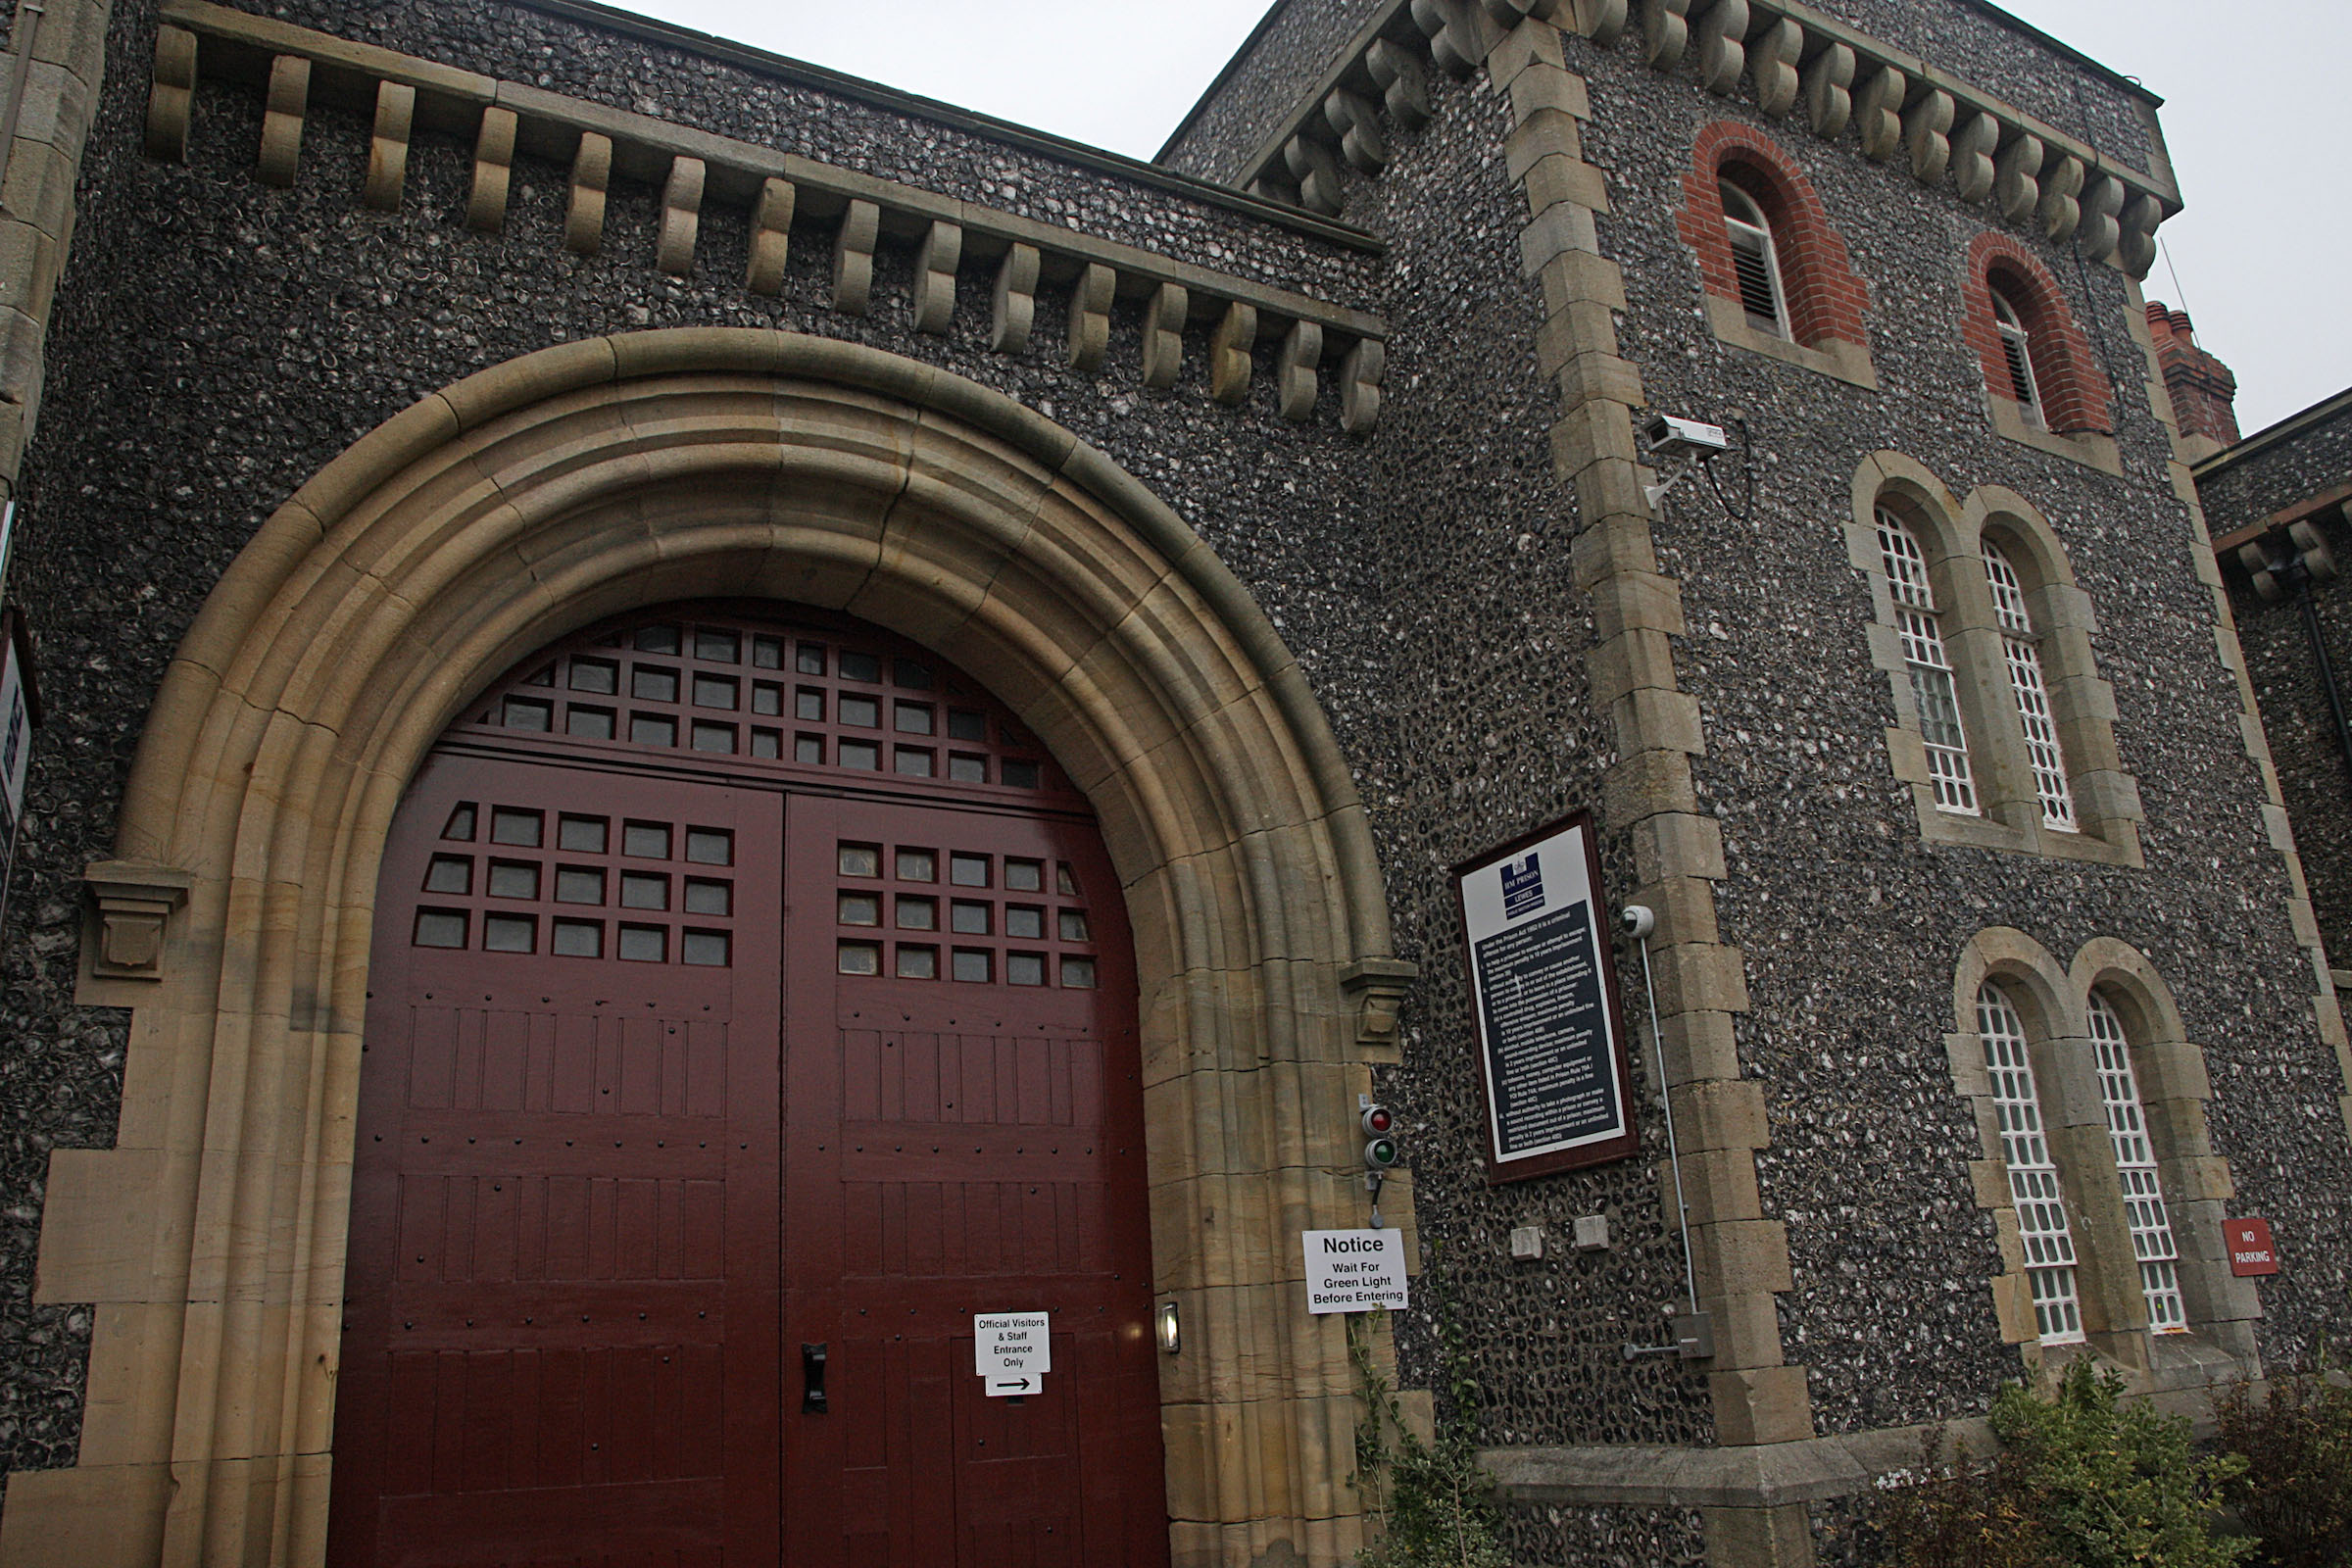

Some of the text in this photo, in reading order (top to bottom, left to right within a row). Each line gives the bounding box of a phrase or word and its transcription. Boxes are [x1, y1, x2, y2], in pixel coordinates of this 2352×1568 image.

[1516, 868, 1539, 885] PRISON
[1514, 889, 1533, 903] LEWES
[2242, 1231, 2254, 1242] NO
[1324, 1237, 1384, 1252] Notice
[2234, 1250, 2270, 1263] PARKING
[1333, 1262, 1380, 1273] Wait For
[1324, 1276, 1392, 1289] Green Light
[1314, 1291, 1403, 1303] Before Entering
[979, 1319, 1009, 1329] Official
[1007, 1332, 1027, 1341] Staff
[994, 1346, 1033, 1354] Entrance
[1004, 1357, 1024, 1368] Only
